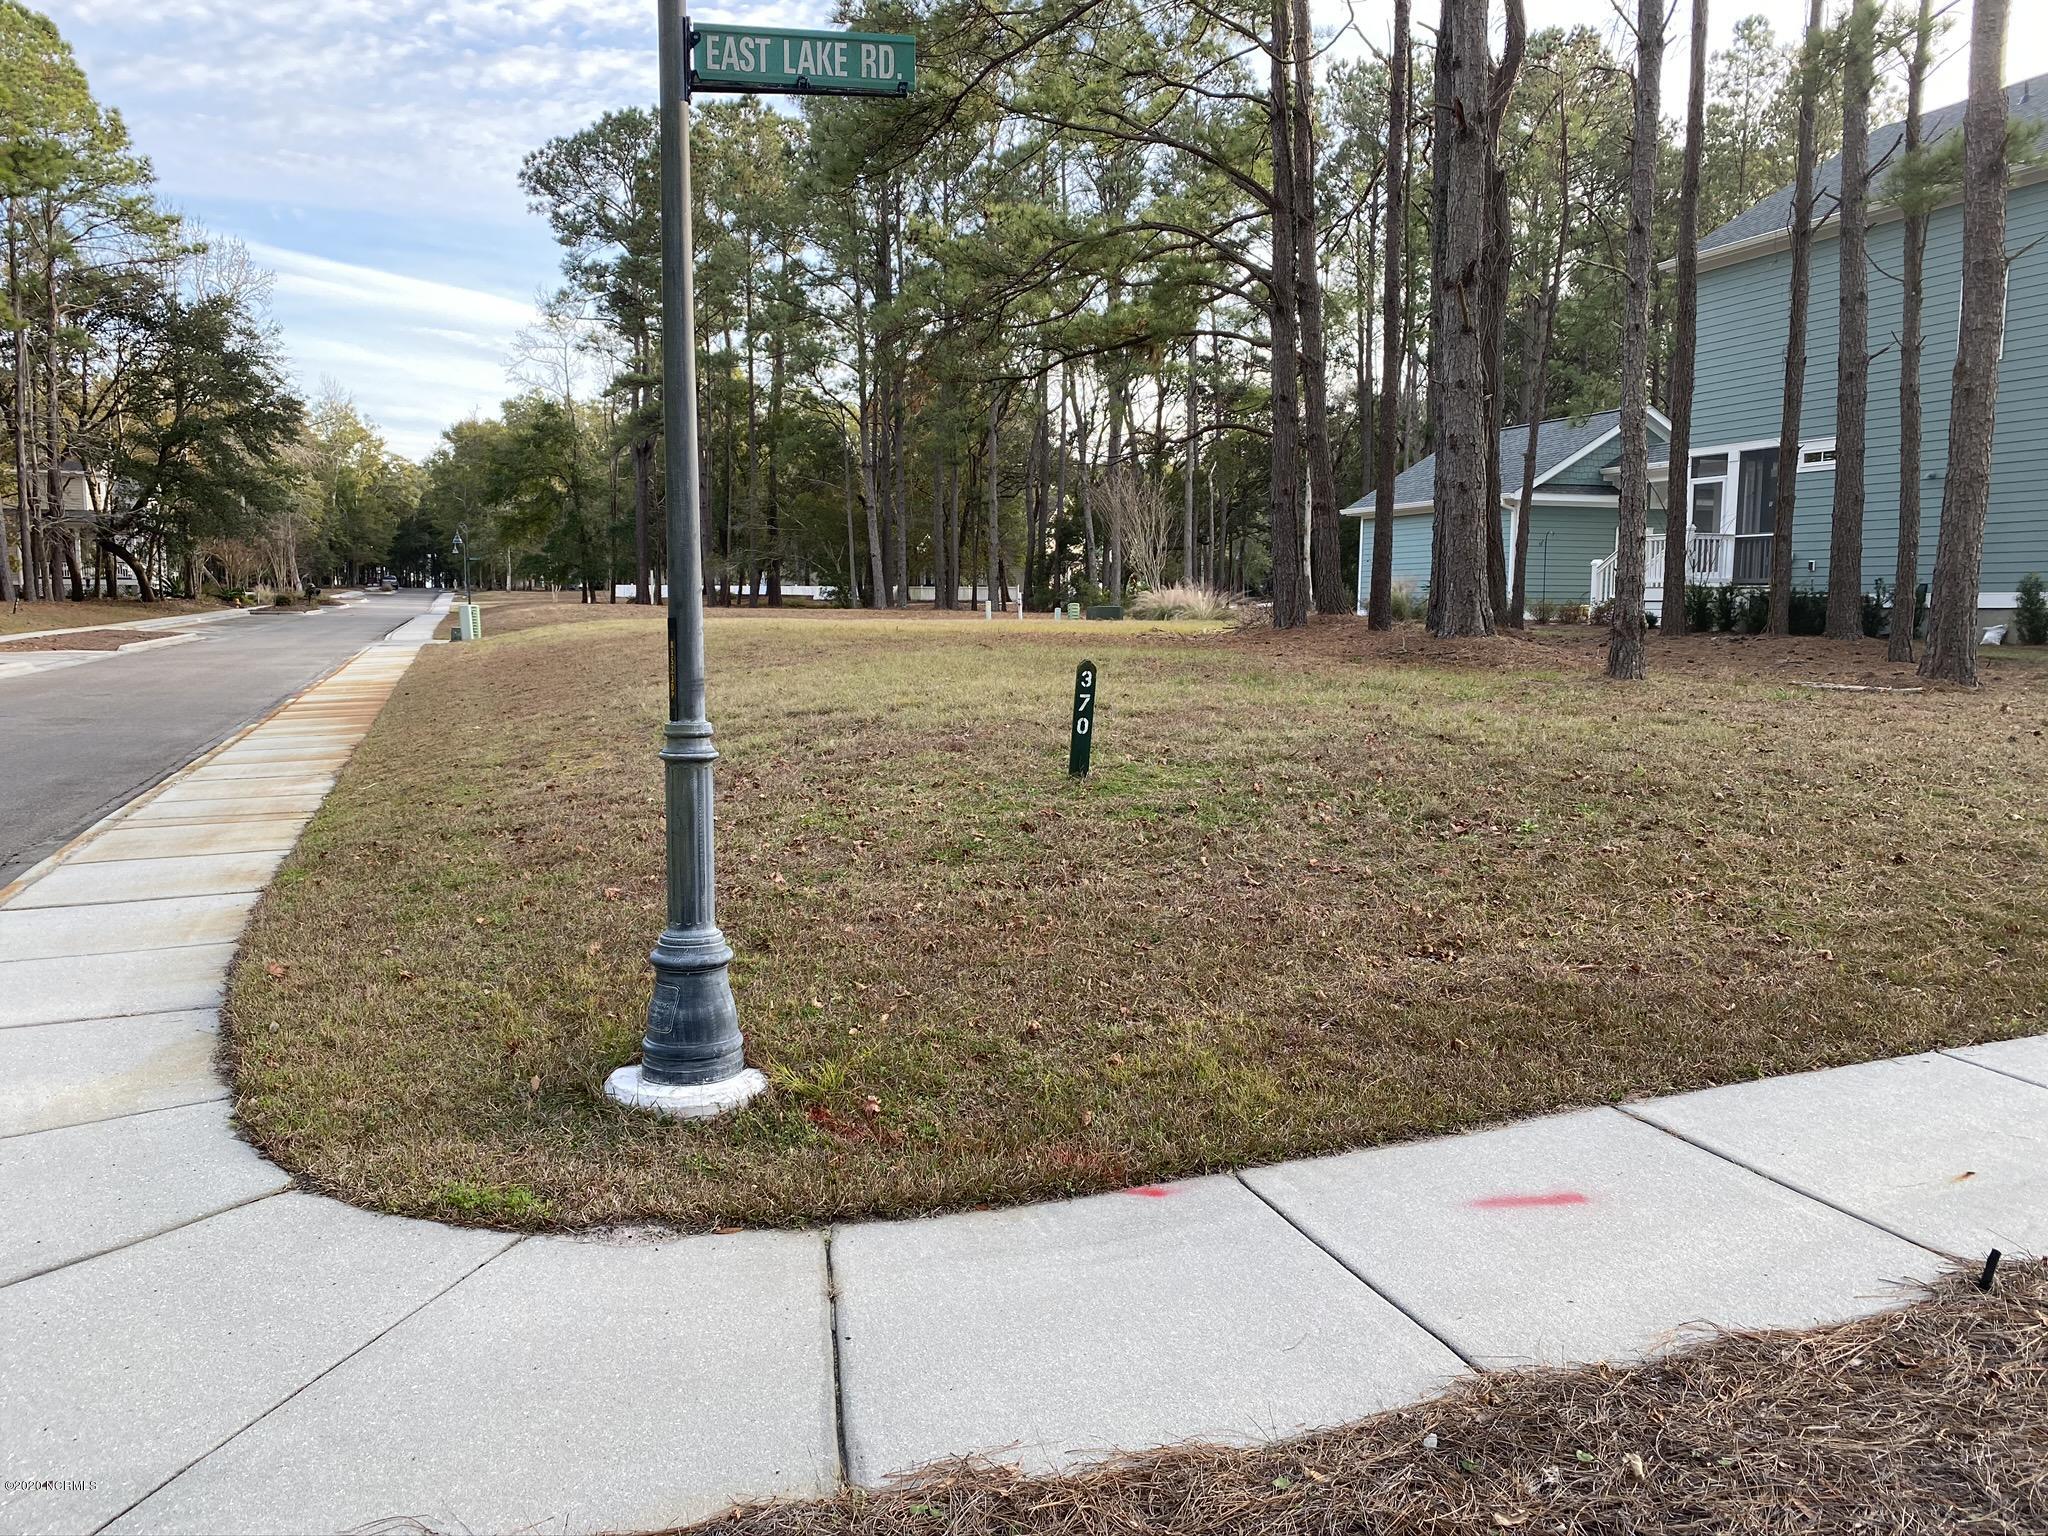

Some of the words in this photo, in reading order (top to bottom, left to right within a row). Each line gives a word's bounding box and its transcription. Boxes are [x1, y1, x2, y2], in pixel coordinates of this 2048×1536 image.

[707, 35, 770, 73] EAST
[783, 39, 848, 77] LAKE
[861, 43, 903, 80] RD.
[1077, 671, 1092, 734] 370
